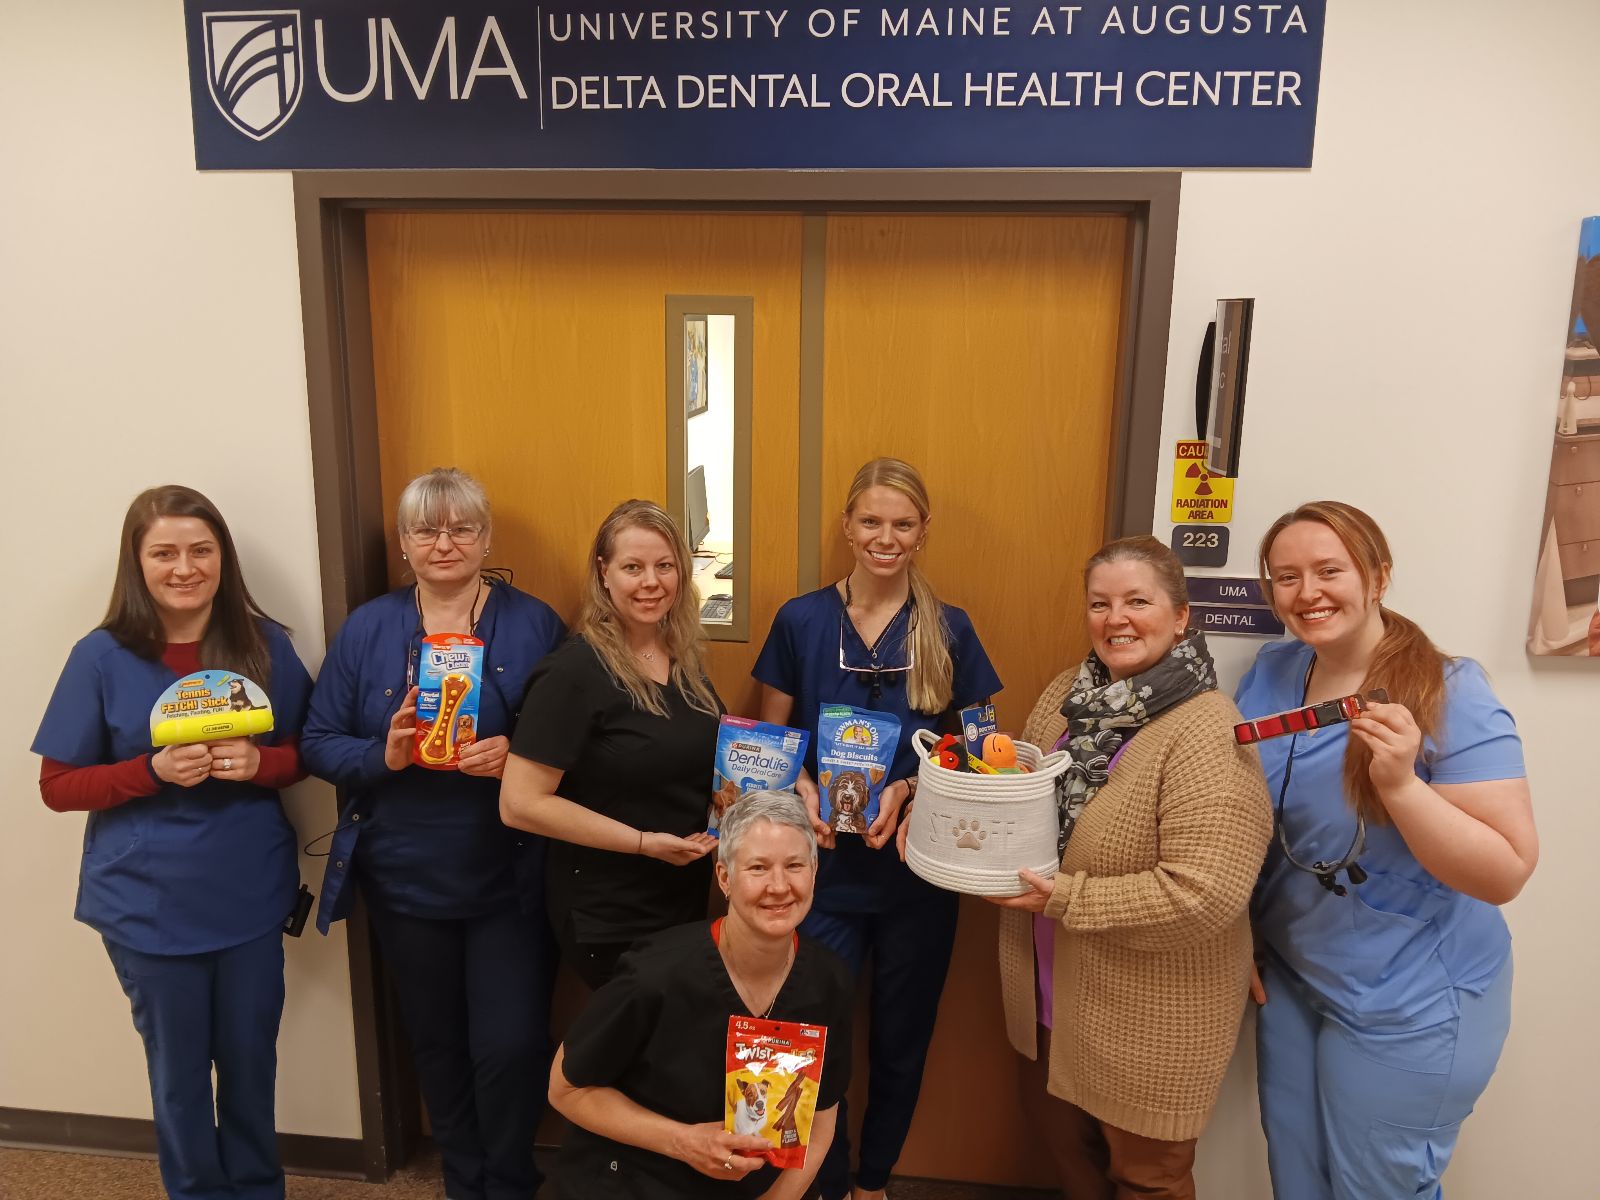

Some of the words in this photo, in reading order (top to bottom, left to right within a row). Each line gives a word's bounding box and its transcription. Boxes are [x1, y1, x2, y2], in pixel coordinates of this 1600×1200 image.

[549, 9, 788, 42] UNIVERSITY
[808, 8, 861, 38] OF
[881, 7, 1011, 37] MAINE
[1031, 6, 1082, 36] AT
[1100, 4, 1308, 35] AUGUSTA
[314, 15, 529, 103] UMA
[551, 75, 667, 110] DELTA
[677, 73, 831, 109] DENTAL
[841, 72, 953, 108] ORAL
[964, 71, 1123, 107] HEALTH
[1135, 70, 1302, 107] CENTER
[1175, 498, 1228, 509] RADIATION
[1187, 510, 1214, 520] AREA
[1182, 532, 1219, 548] 223
[1219, 585, 1248, 597] UMA
[1204, 613, 1256, 626] DENTAL
[176, 687, 211, 700] Tennis
[161, 700, 198, 714] FETCH!
[201, 696, 229, 709] Stick
[834, 719, 872, 743] NEWMAN'S
[831, 749, 846, 758] Dog
[847, 751, 878, 762] Biscuits
[731, 763, 751, 774] Daily
[750, 767, 767, 776] Oral
[766, 770, 782, 779] Care
[735, 1020, 749, 1030] 4.5
